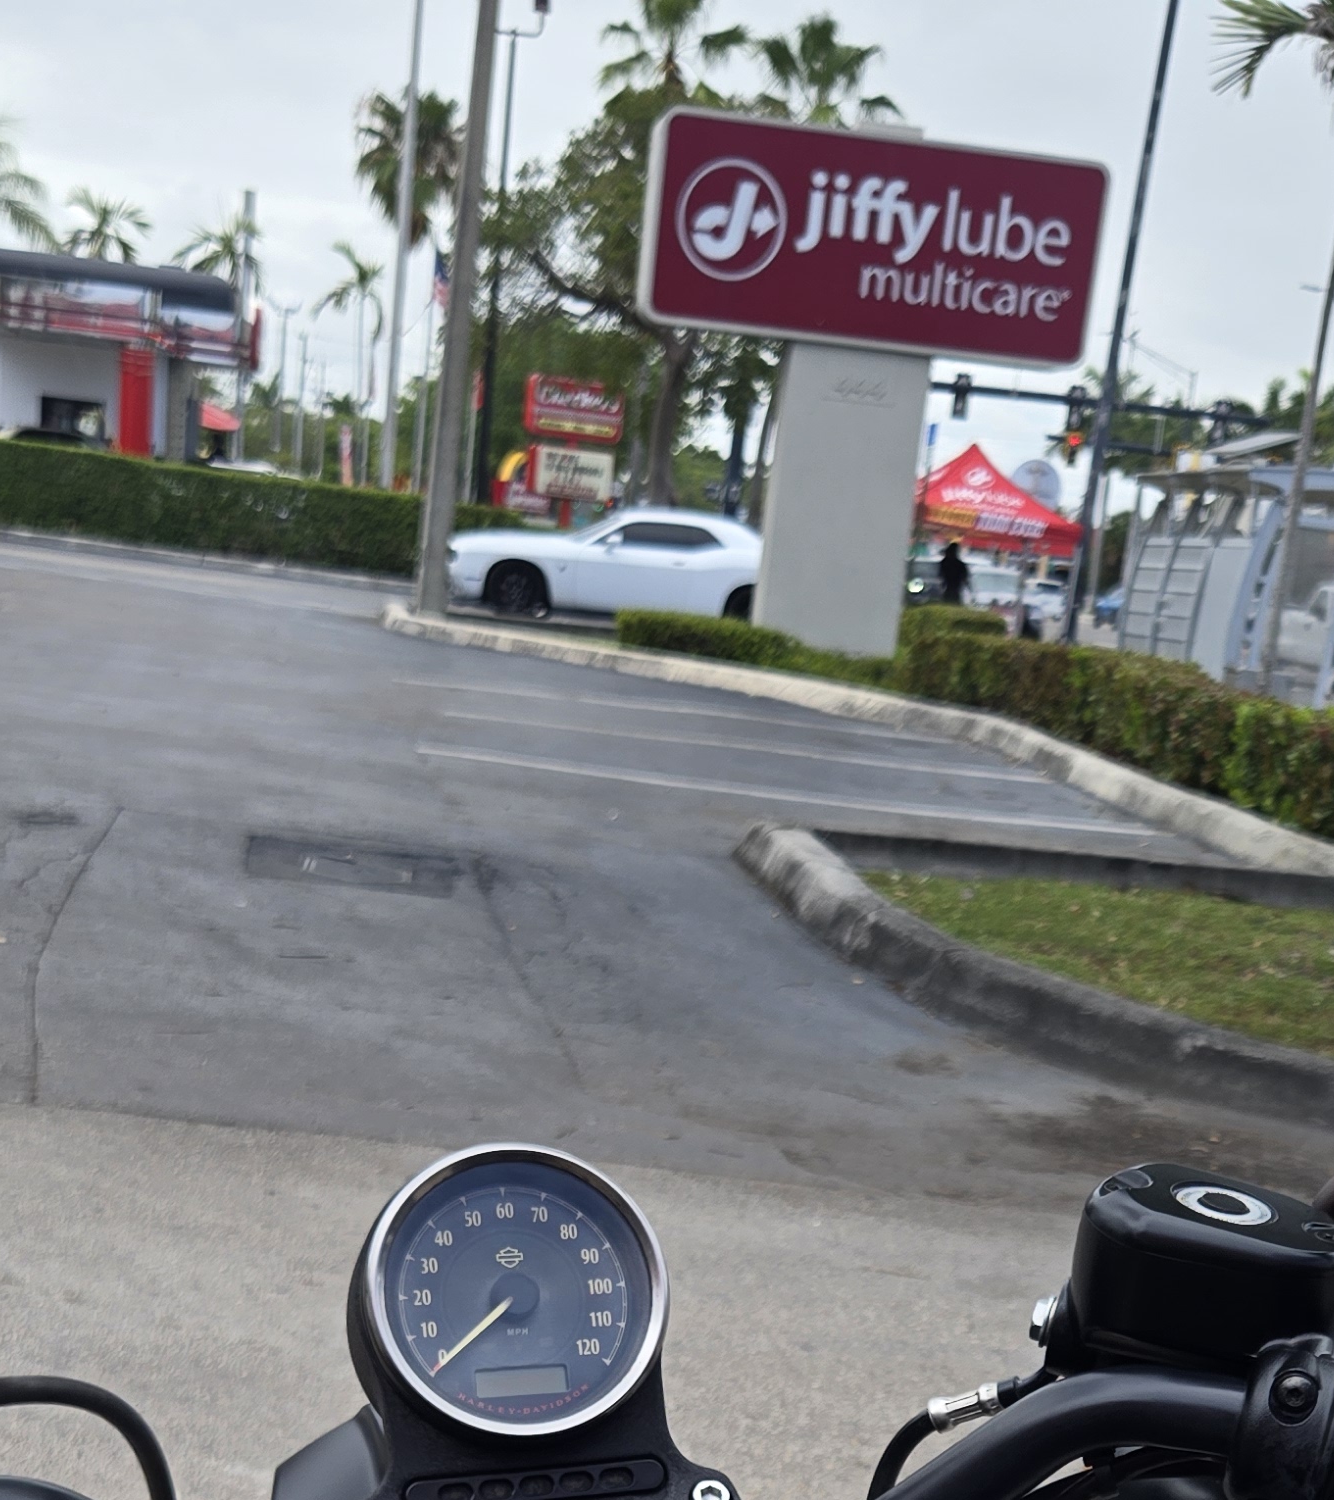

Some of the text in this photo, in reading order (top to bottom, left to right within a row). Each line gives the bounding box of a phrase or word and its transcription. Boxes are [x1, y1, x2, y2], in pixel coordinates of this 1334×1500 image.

[859, 260, 1061, 322] multicare
[464, 1210, 482, 1227] 50
[496, 1202, 514, 1219] 60
[531, 1206, 548, 1223] 70
[434, 1230, 453, 1246] 40
[560, 1223, 578, 1240] 80
[581, 1248, 599, 1264] 90
[421, 1257, 438, 1274] 30
[587, 1278, 613, 1295] 100
[413, 1289, 431, 1306] 20
[589, 1311, 612, 1327] 110
[420, 1321, 437, 1338] 10
[507, 1327, 529, 1336] MPH
[576, 1338, 600, 1355] 120
